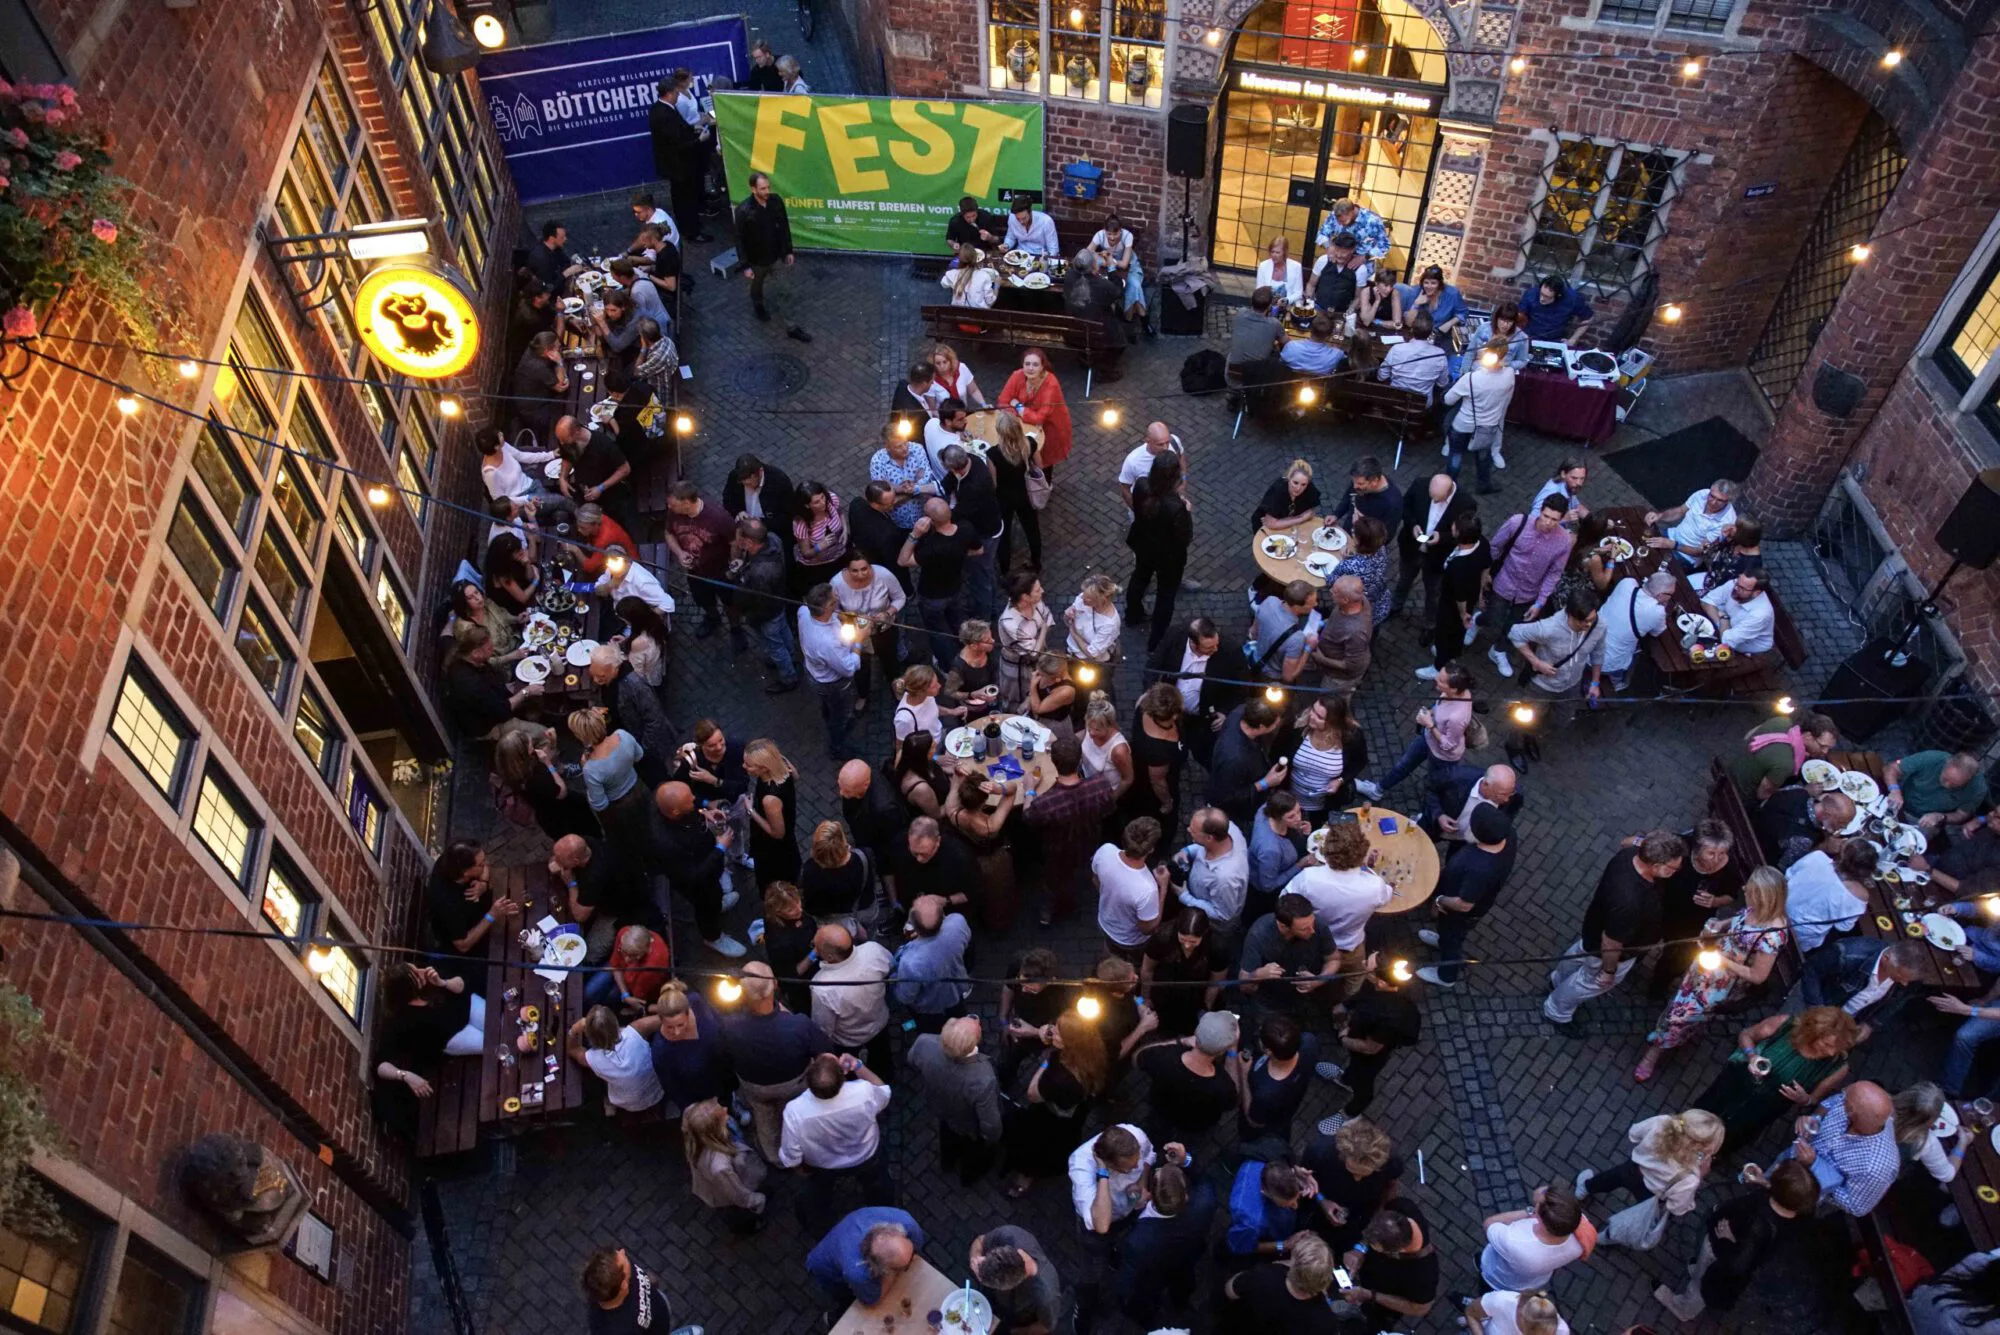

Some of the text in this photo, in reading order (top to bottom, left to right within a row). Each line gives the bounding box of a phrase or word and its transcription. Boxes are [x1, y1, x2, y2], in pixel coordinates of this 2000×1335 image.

[577, 76, 616, 88] HERZLICH
[548, 109, 649, 132] DIE MEDIENHÄUSER BÖTT
[750, 95, 1026, 199] FEST
[784, 196, 825, 209] FÜNFTE
[827, 199, 875, 211] FILMFEST
[879, 202, 925, 214] BREMEN
[928, 205, 954, 215] vom
[633, 1263, 647, 1326] Superdry
